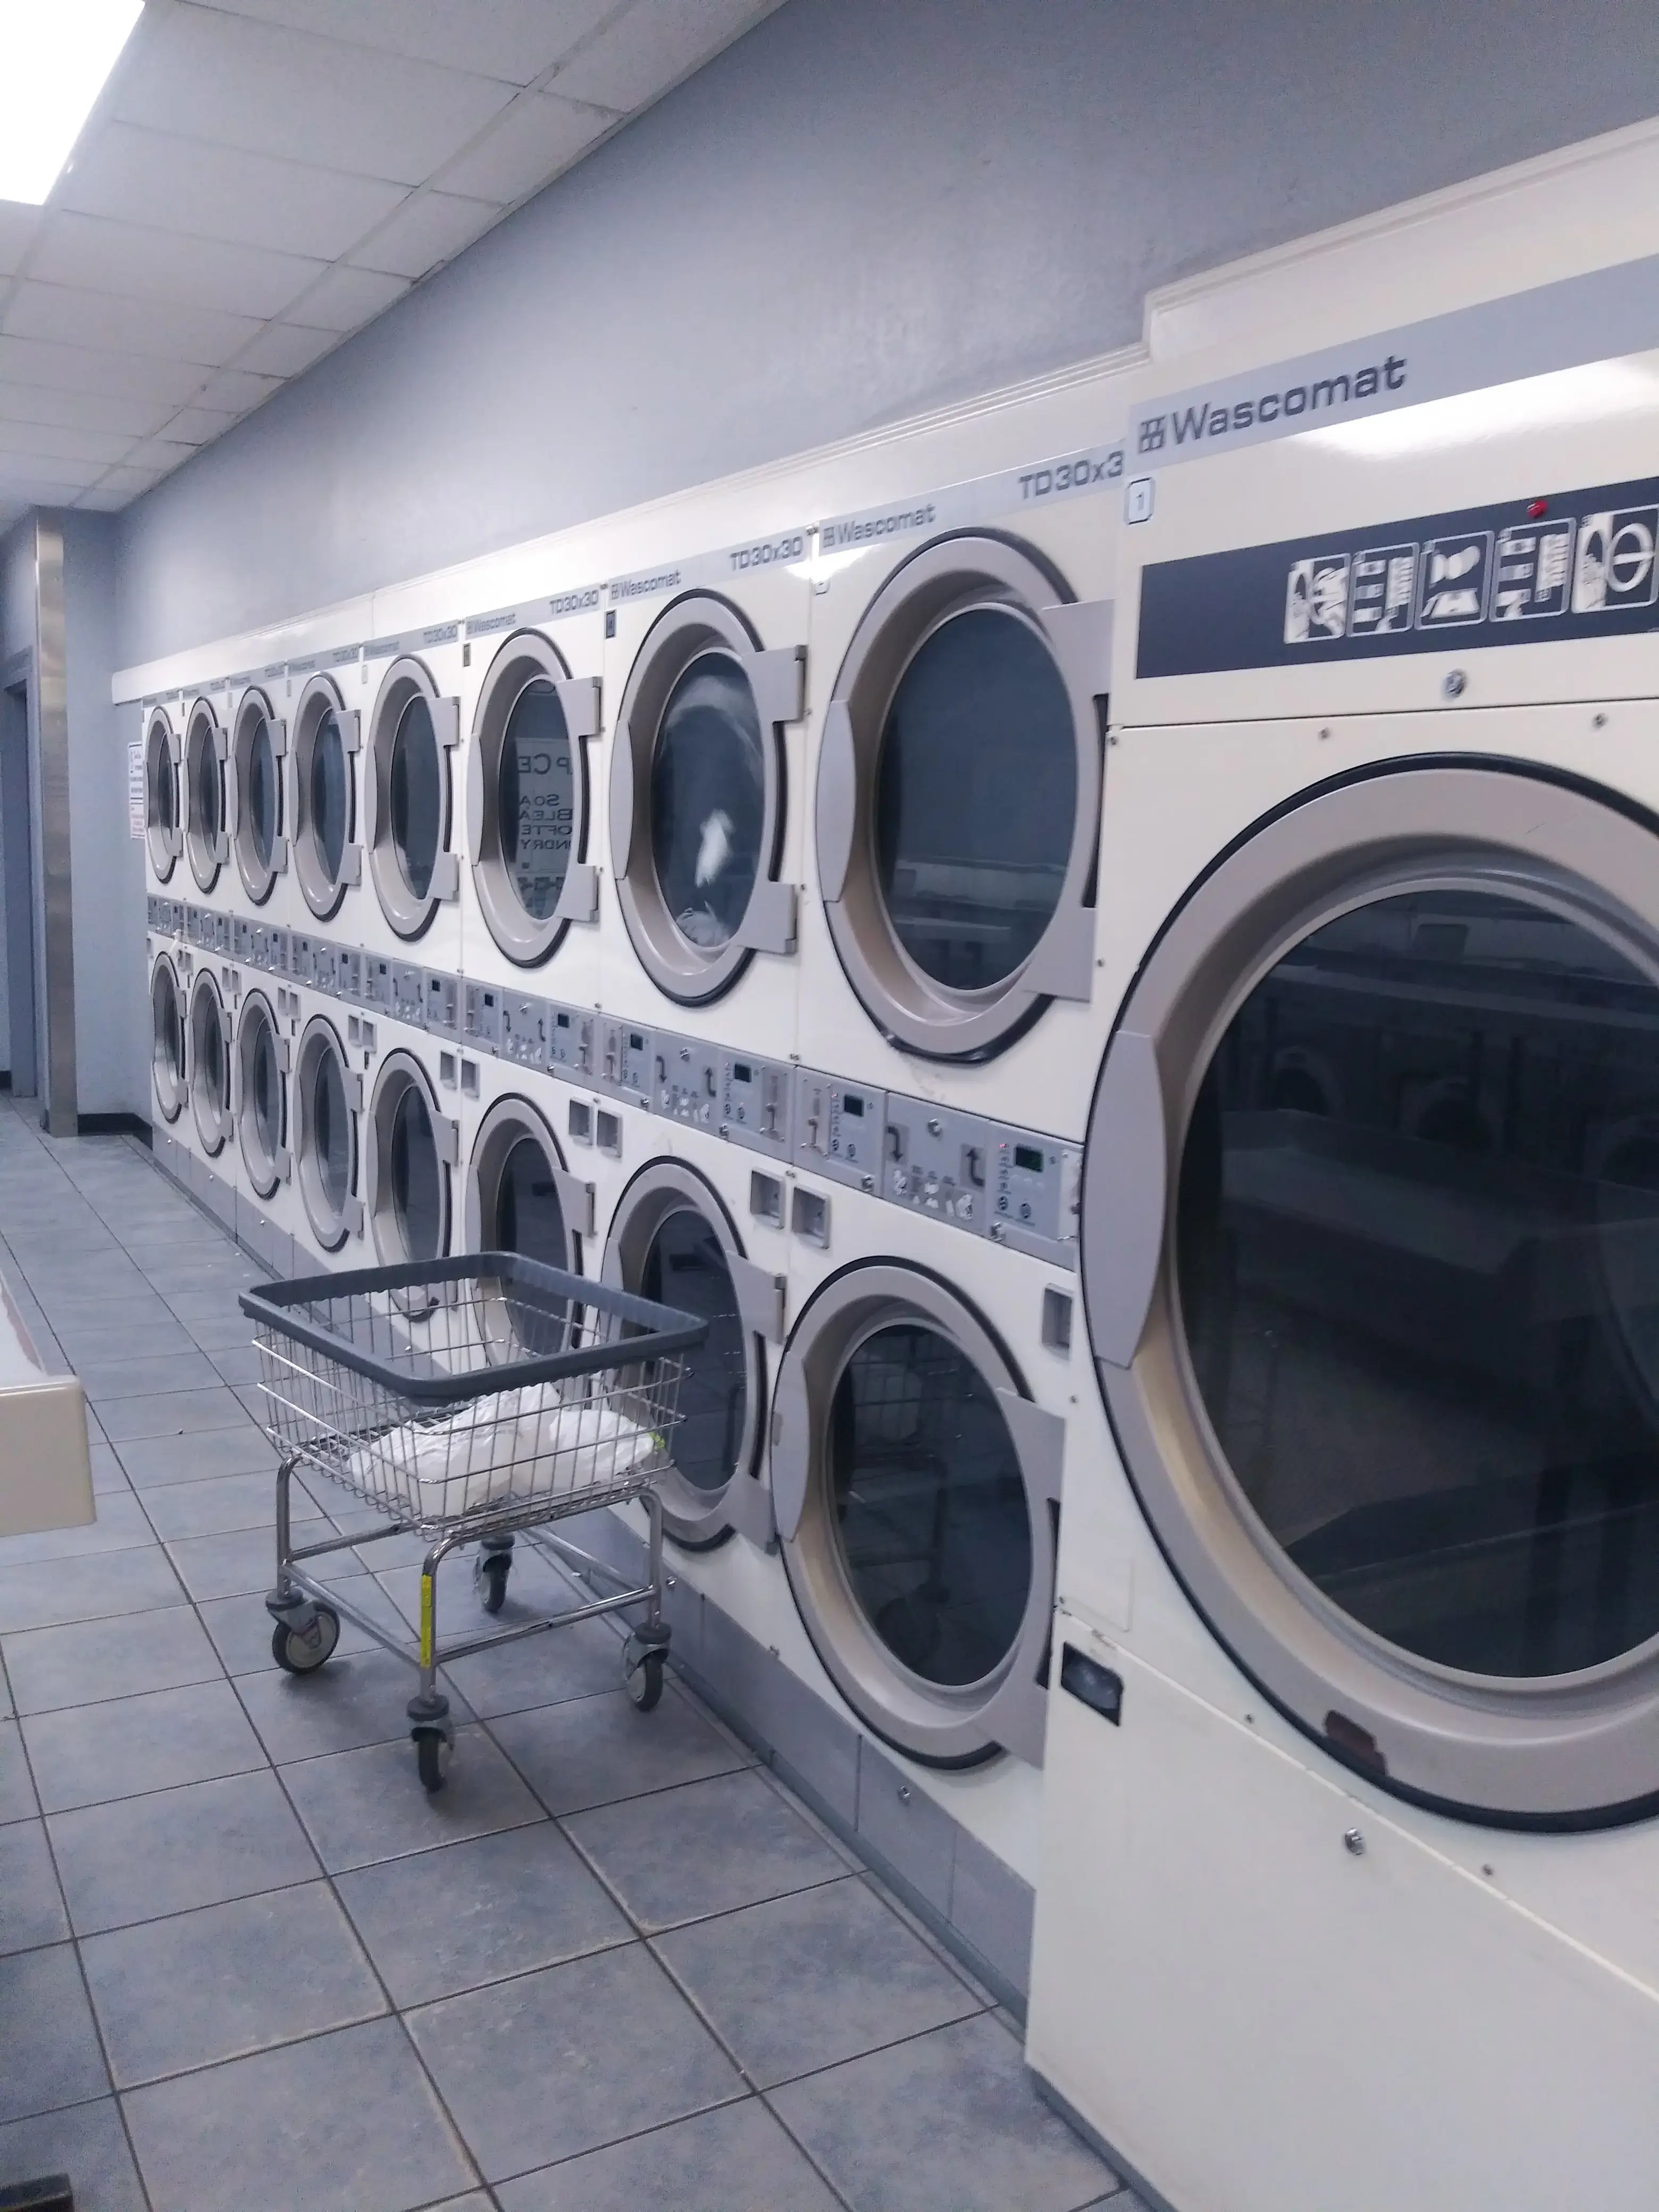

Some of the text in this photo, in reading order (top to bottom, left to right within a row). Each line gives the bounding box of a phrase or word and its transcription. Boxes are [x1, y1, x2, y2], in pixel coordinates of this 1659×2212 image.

[1172, 355, 1407, 445] Wascomat
[1019, 449, 1124, 500] TD30x3
[1135, 491, 1145, 512] 1
[835, 502, 936, 543] Wascomat
[730, 536, 803, 572] TD30x30
[621, 569, 682, 598] Wascomat
[549, 589, 599, 615] TD30x30
